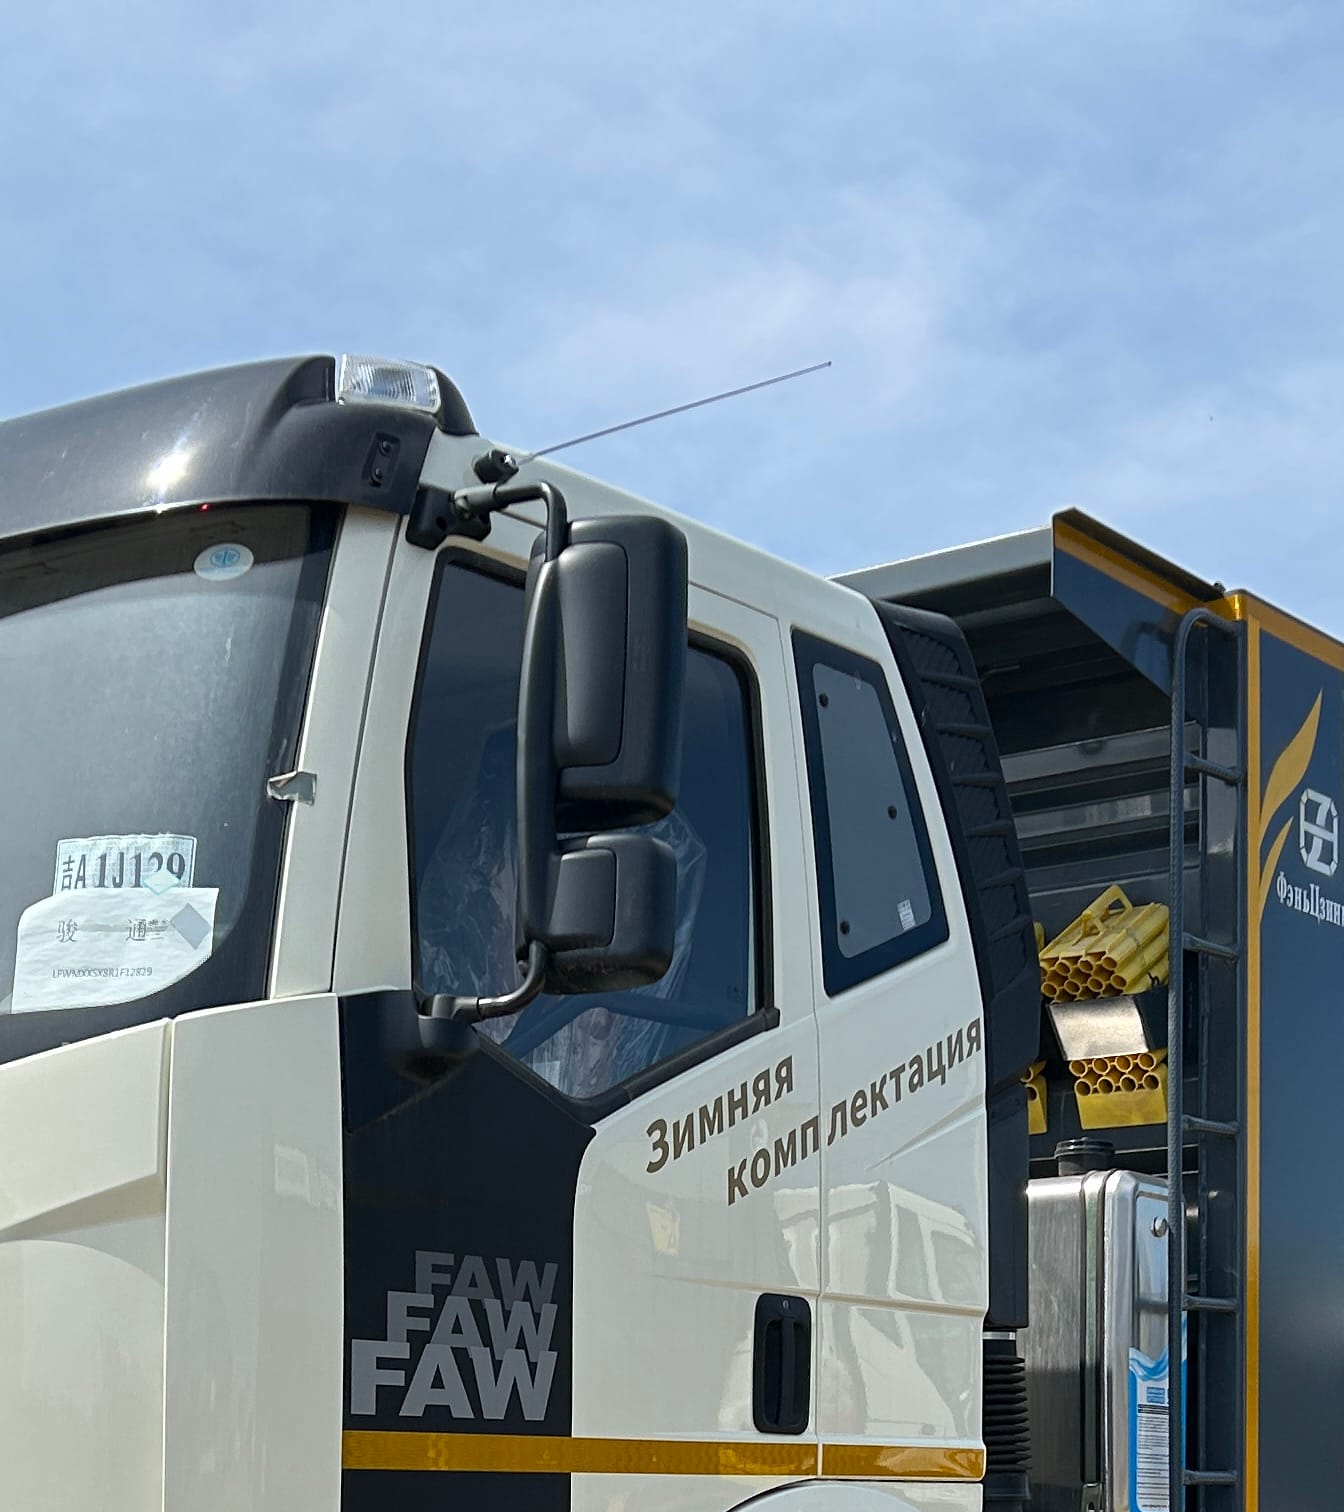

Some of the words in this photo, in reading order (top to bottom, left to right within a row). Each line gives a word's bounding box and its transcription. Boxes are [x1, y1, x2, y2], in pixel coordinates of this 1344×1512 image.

[646, 1055, 794, 1174] Зимняя
[727, 1017, 982, 1207] комплектация
[415, 1250, 559, 1313] FAW
[387, 1290, 558, 1362] FAW
[350, 1338, 558, 1421] FAW
